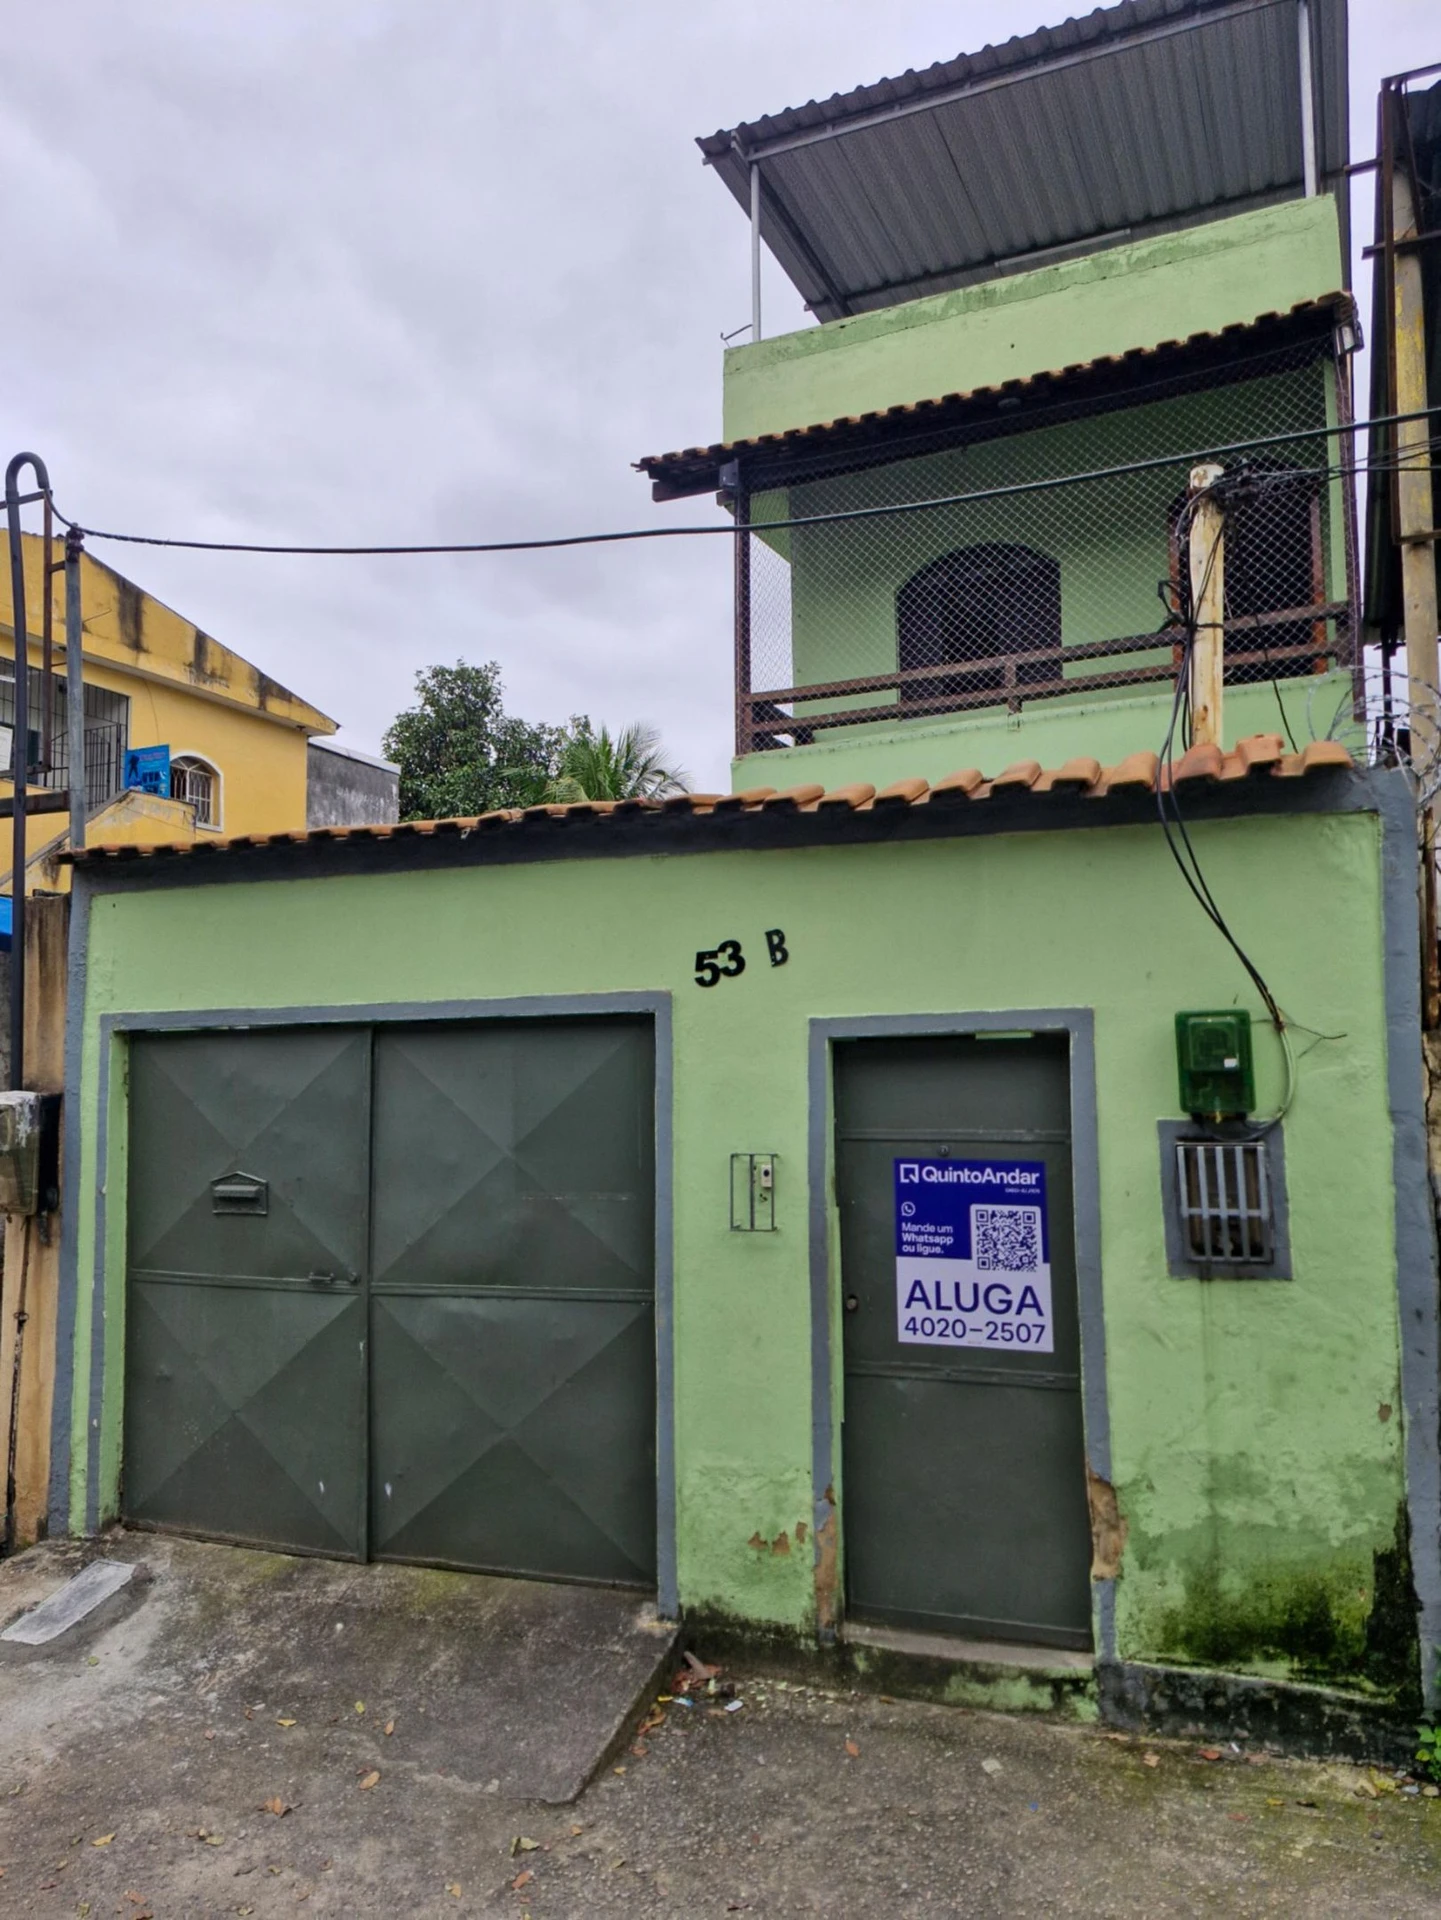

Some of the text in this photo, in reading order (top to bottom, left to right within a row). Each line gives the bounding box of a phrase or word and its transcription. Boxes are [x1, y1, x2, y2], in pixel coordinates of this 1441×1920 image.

[694, 928, 789, 988] 53 B
[921, 1165, 1040, 1185] QuintoAndar
[901, 1222, 954, 1234] Mande um
[901, 1232, 954, 1246] Whatsapp
[902, 1243, 944, 1255] ou ligue.
[904, 1279, 1045, 1317] ALUGA
[904, 1316, 1046, 1344] 4020-2507
